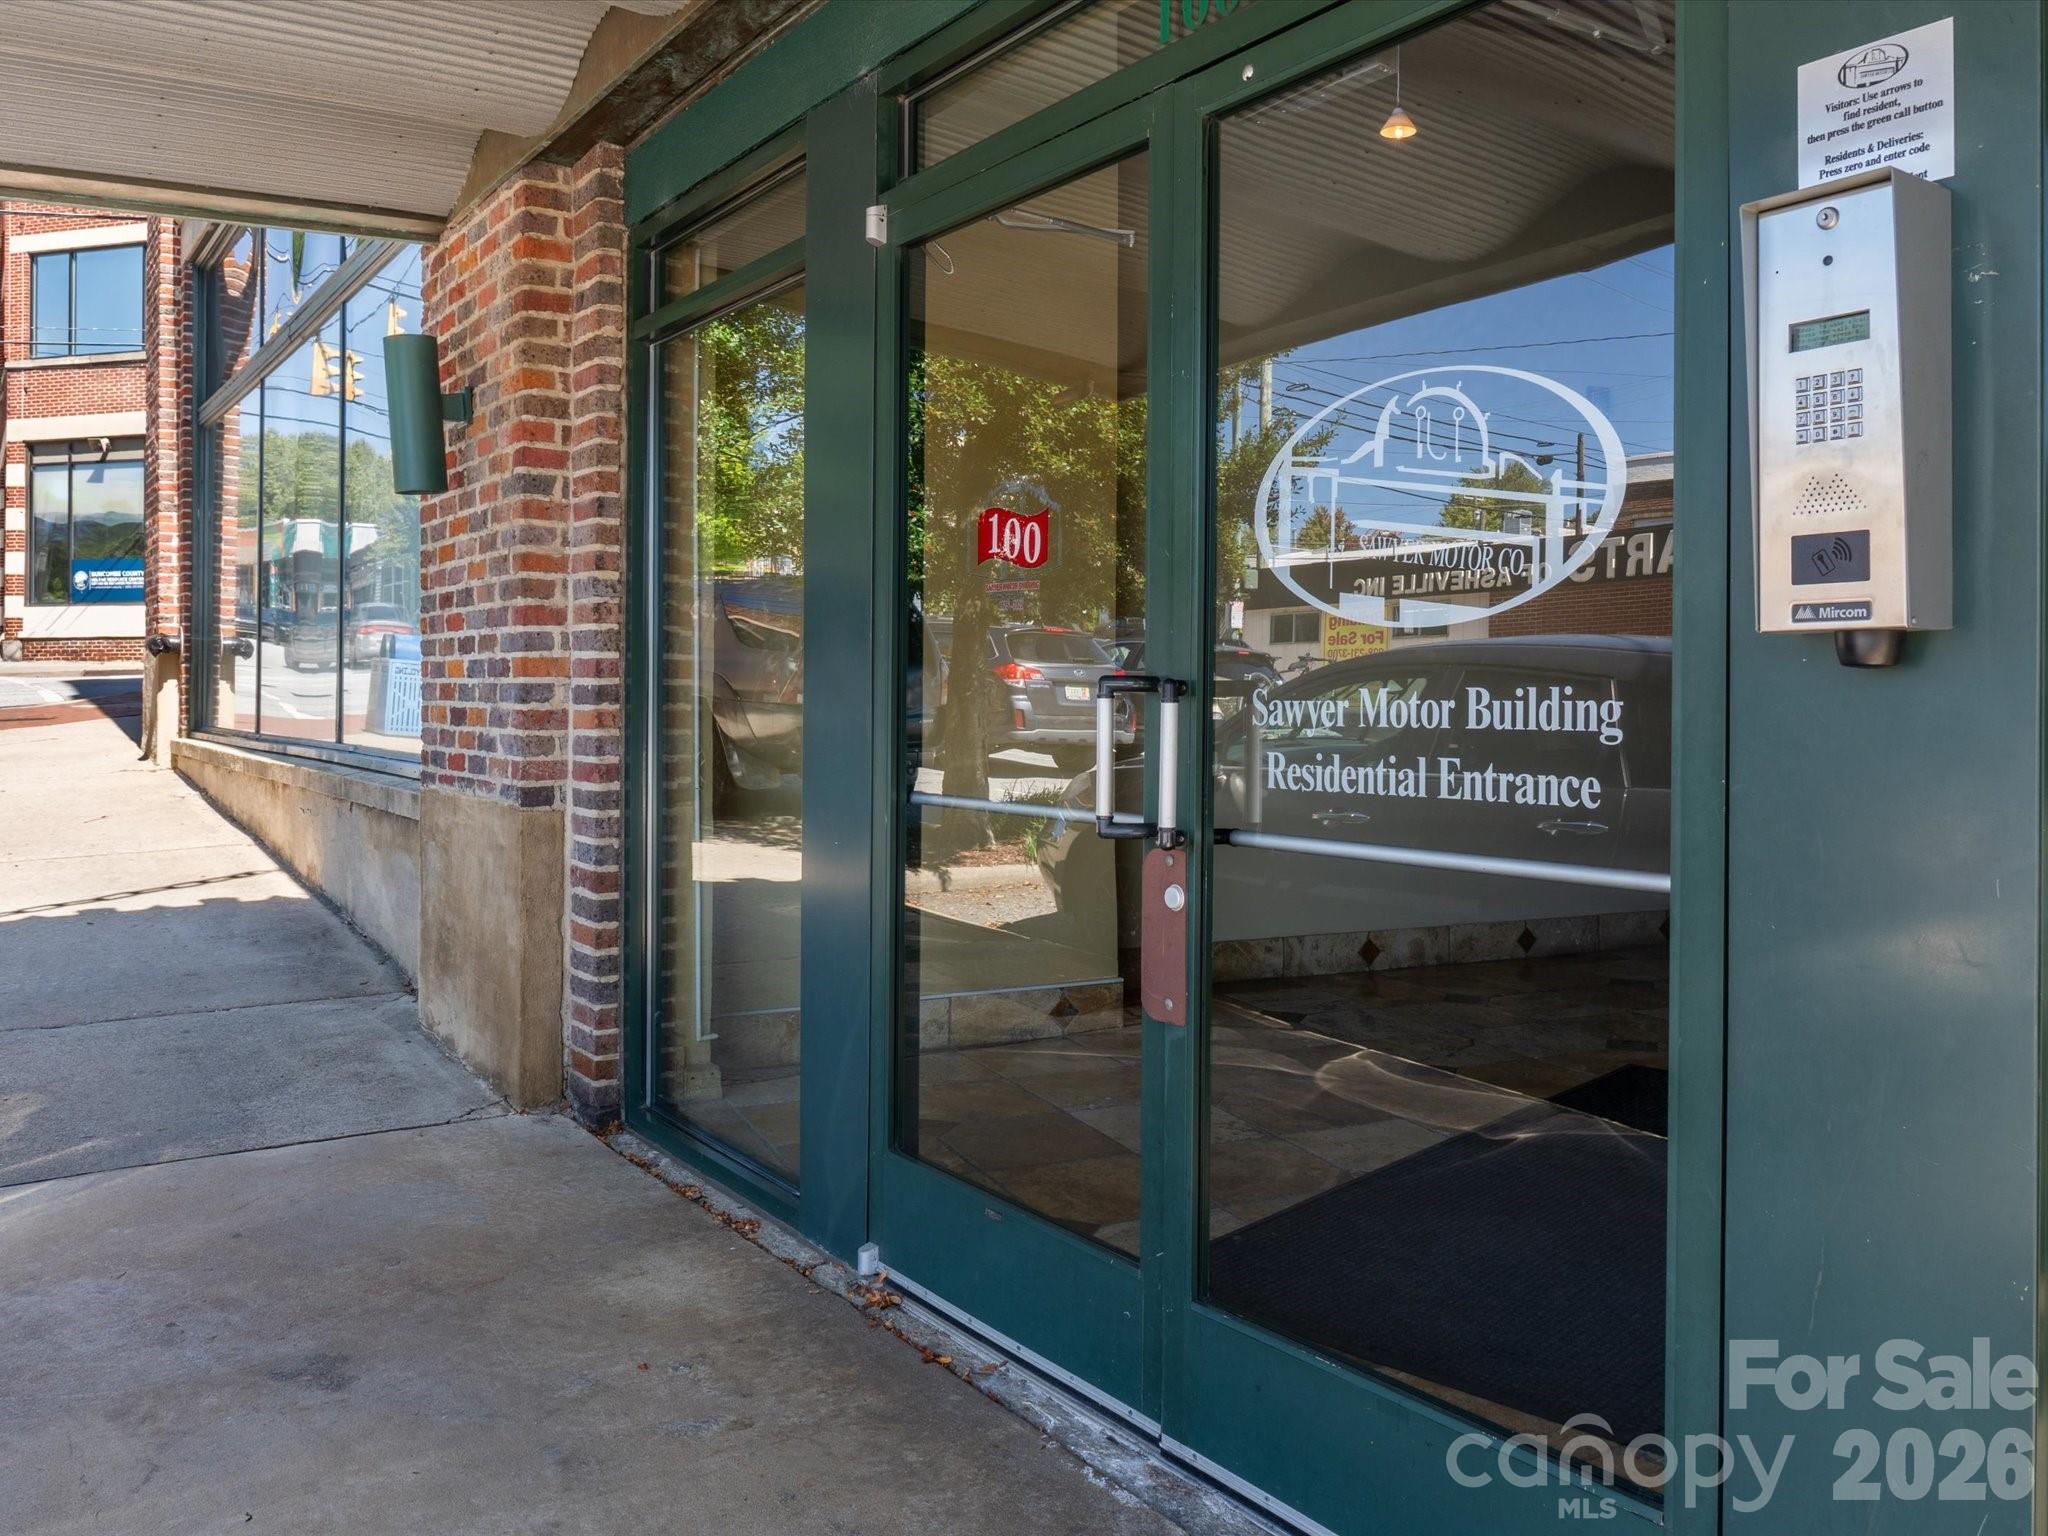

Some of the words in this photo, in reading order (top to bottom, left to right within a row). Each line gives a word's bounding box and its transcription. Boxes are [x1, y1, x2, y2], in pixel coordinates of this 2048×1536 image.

[1825, 97, 1860, 113] Visitors:
[1862, 92, 1879, 103] Use
[1880, 82, 1912, 97] arrows
[1913, 78, 1924, 88] to
[1843, 107, 1861, 121] find
[1863, 98, 1902, 116] resident,
[1807, 133, 1826, 144] then
[1827, 127, 1850, 141] press
[1851, 120, 1865, 132] the
[1867, 115, 1892, 129] green
[1893, 106, 1911, 120] call
[1913, 99, 1944, 114] button
[1819, 168, 1843, 180] Press
[1844, 162, 1863, 173] zero
[1865, 155, 1882, 167] and
[1884, 150, 1907, 163] enter
[1909, 142, 1931, 155] code
[1824, 146, 1866, 166] Residents
[1867, 144, 1875, 153] &
[1877, 131, 1924, 151] Deliveries:
[988, 513, 1042, 564] 100
[1429, 543, 1494, 571] MOTOR
[1819, 606, 1867, 618] Mircom
[1252, 688, 1350, 737] Sawyer
[1358, 688, 1456, 729] Motor
[1465, 686, 1624, 746] Building
[1266, 751, 1427, 799] Residential
[1437, 757, 1601, 810] Entrance
